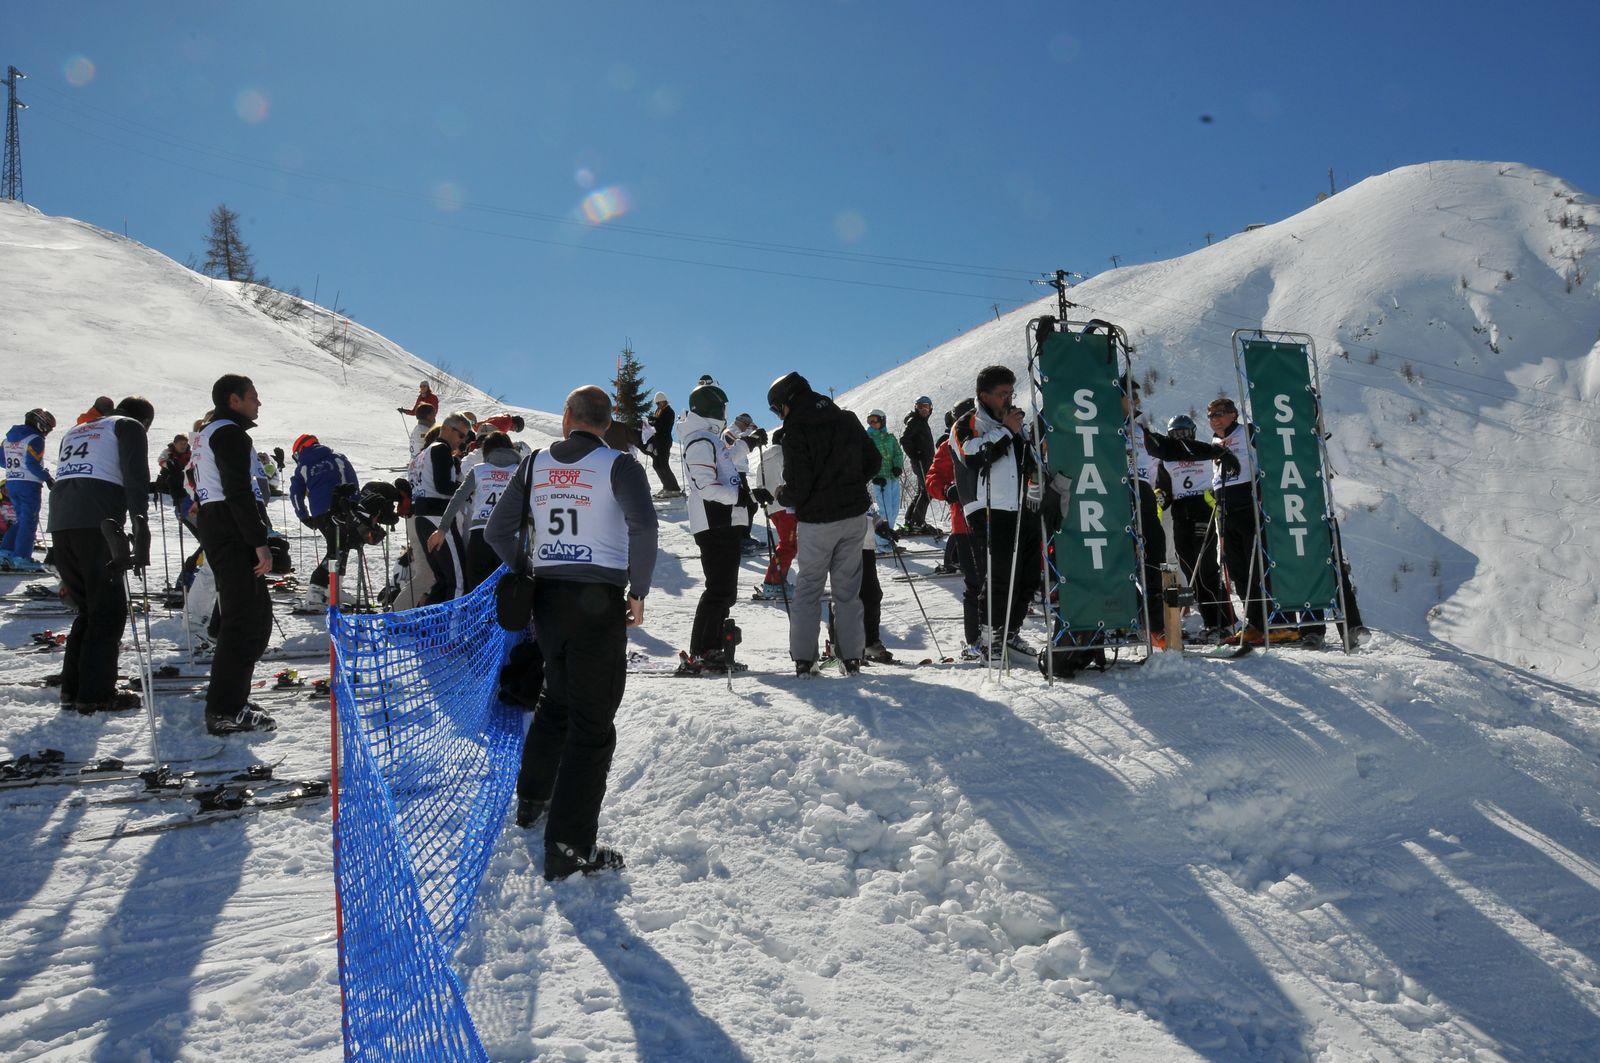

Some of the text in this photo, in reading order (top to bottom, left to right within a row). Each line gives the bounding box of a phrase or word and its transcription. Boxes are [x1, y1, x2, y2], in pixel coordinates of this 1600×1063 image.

[60, 442, 89, 462] 34
[549, 475, 580, 485] SPORT
[1073, 388, 1108, 570] START
[1183, 476, 1193, 489] 6
[1273, 393, 1308, 557] START
[550, 493, 590, 502] BONALDI
[548, 507, 578, 536] 51
[538, 539, 592, 563] CLAN2
